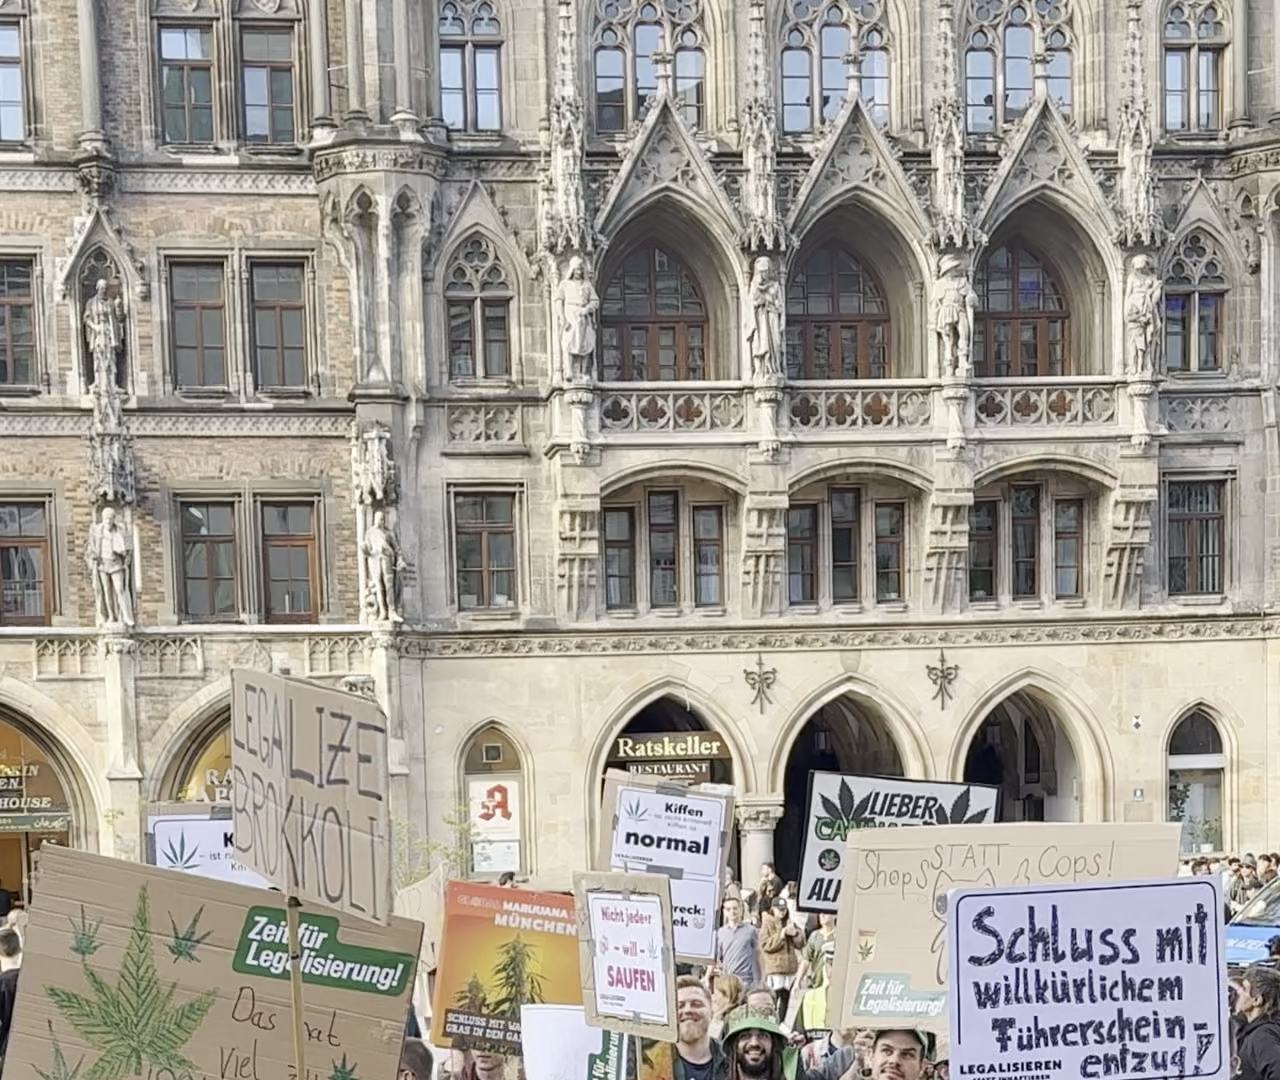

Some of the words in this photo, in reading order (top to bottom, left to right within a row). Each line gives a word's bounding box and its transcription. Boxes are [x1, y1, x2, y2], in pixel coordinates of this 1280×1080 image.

[233, 684, 385, 801] LEGALIZE
[617, 735, 721, 757] Ratskeller
[629, 763, 708, 774] RESTAURANT
[664, 802, 703, 818] Kiffen
[870, 790, 939, 821] LIEBER
[234, 765, 381, 920] BROKKOLI
[624, 831, 710, 856] normal
[930, 843, 1010, 871] STATT
[1039, 841, 1115, 883] Cops!
[672, 904, 705, 916] reck:
[494, 912, 577, 937] MÜNCHEN
[967, 904, 1140, 967] Schluss
[1155, 903, 1210, 966] mit
[607, 965, 656, 993] SAUFEN
[860, 978, 886, 995] Zeit
[972, 967, 1184, 1010] willkürlichem
[231, 985, 277, 1031] Das
[859, 995, 946, 1017] Legalisierung!
[959, 1059, 1063, 1076] LEGALISIEREN
